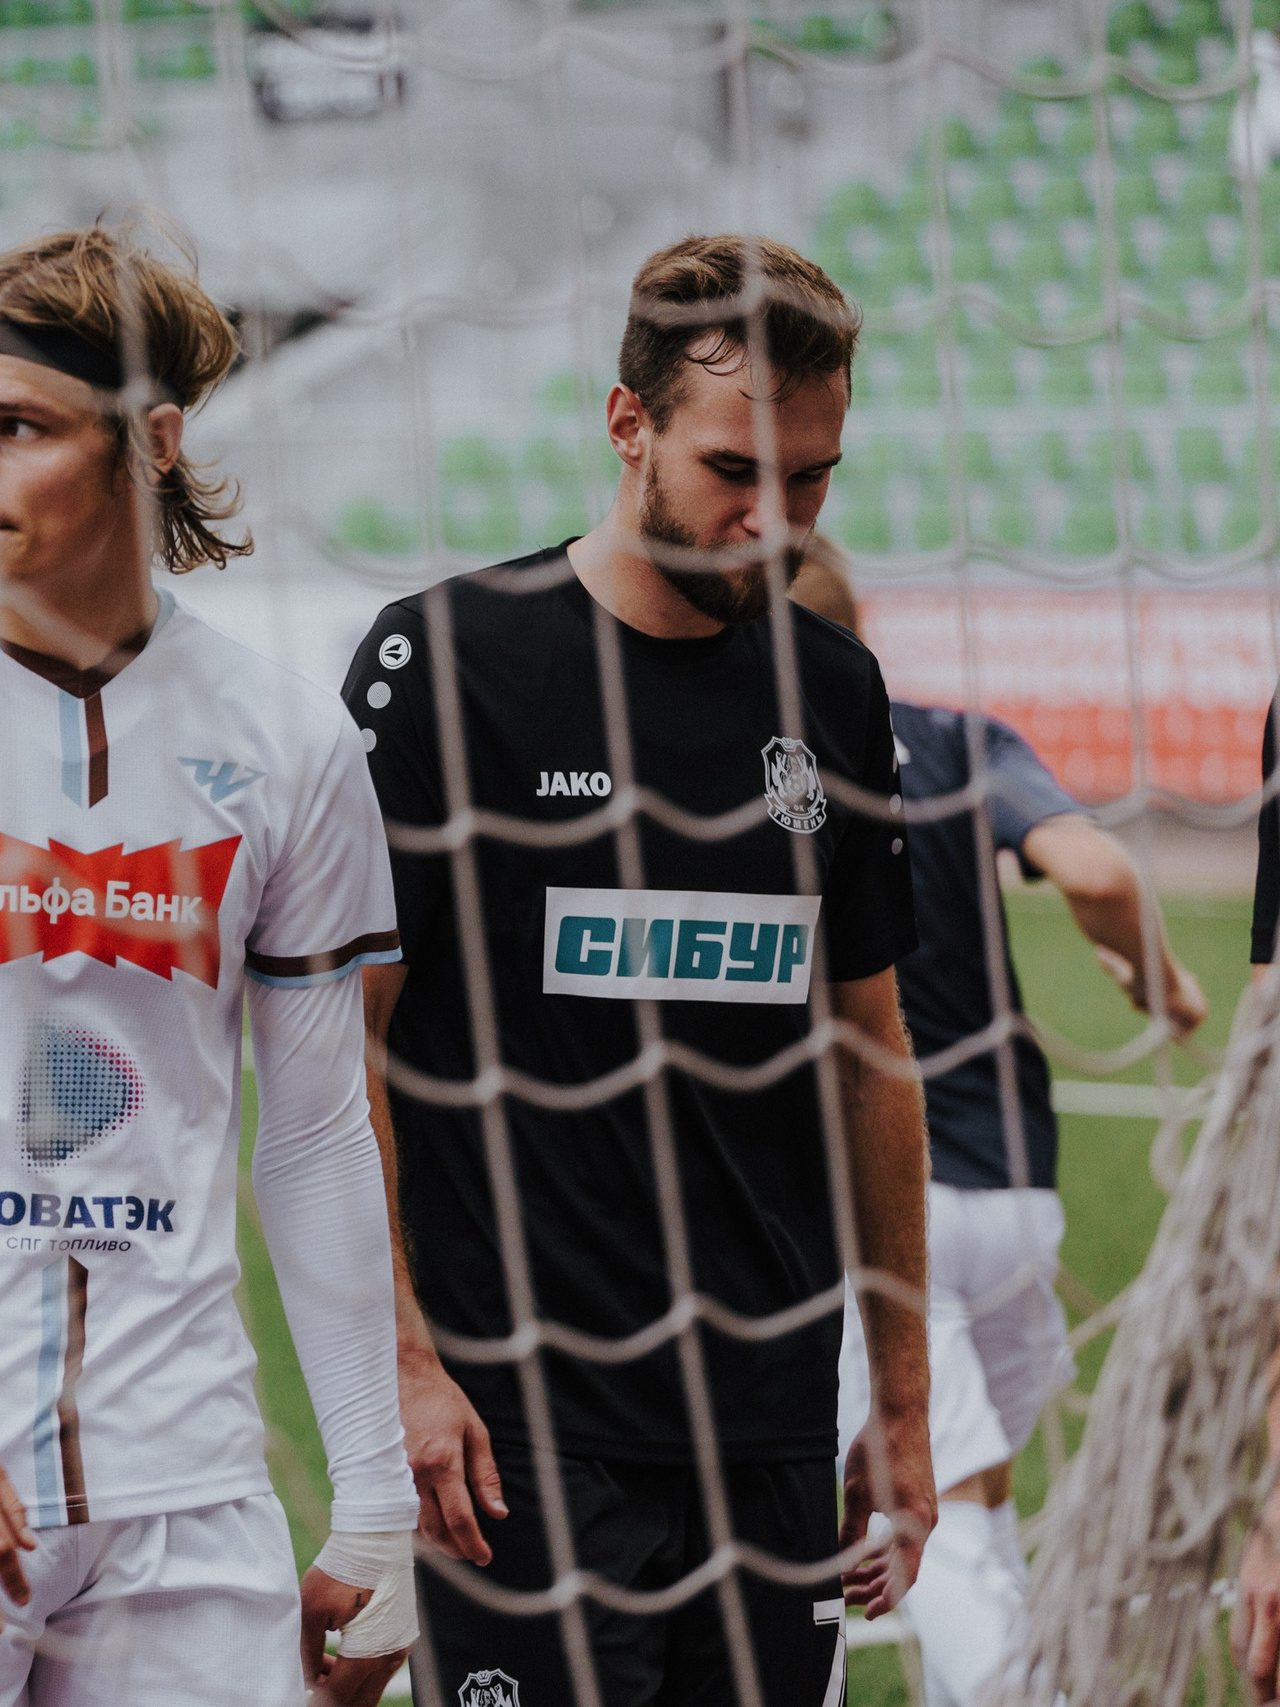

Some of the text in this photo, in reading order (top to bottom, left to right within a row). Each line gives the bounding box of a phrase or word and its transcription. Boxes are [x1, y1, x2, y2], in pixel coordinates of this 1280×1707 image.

[536, 771, 612, 798] JAKO
[773, 809, 823, 829] ТЮМЕНЬ
[105, 880, 203, 923] Банк
[554, 915, 810, 983] СИБУР
[6, 1236, 132, 1252] СПГ ТОПЛИВО
